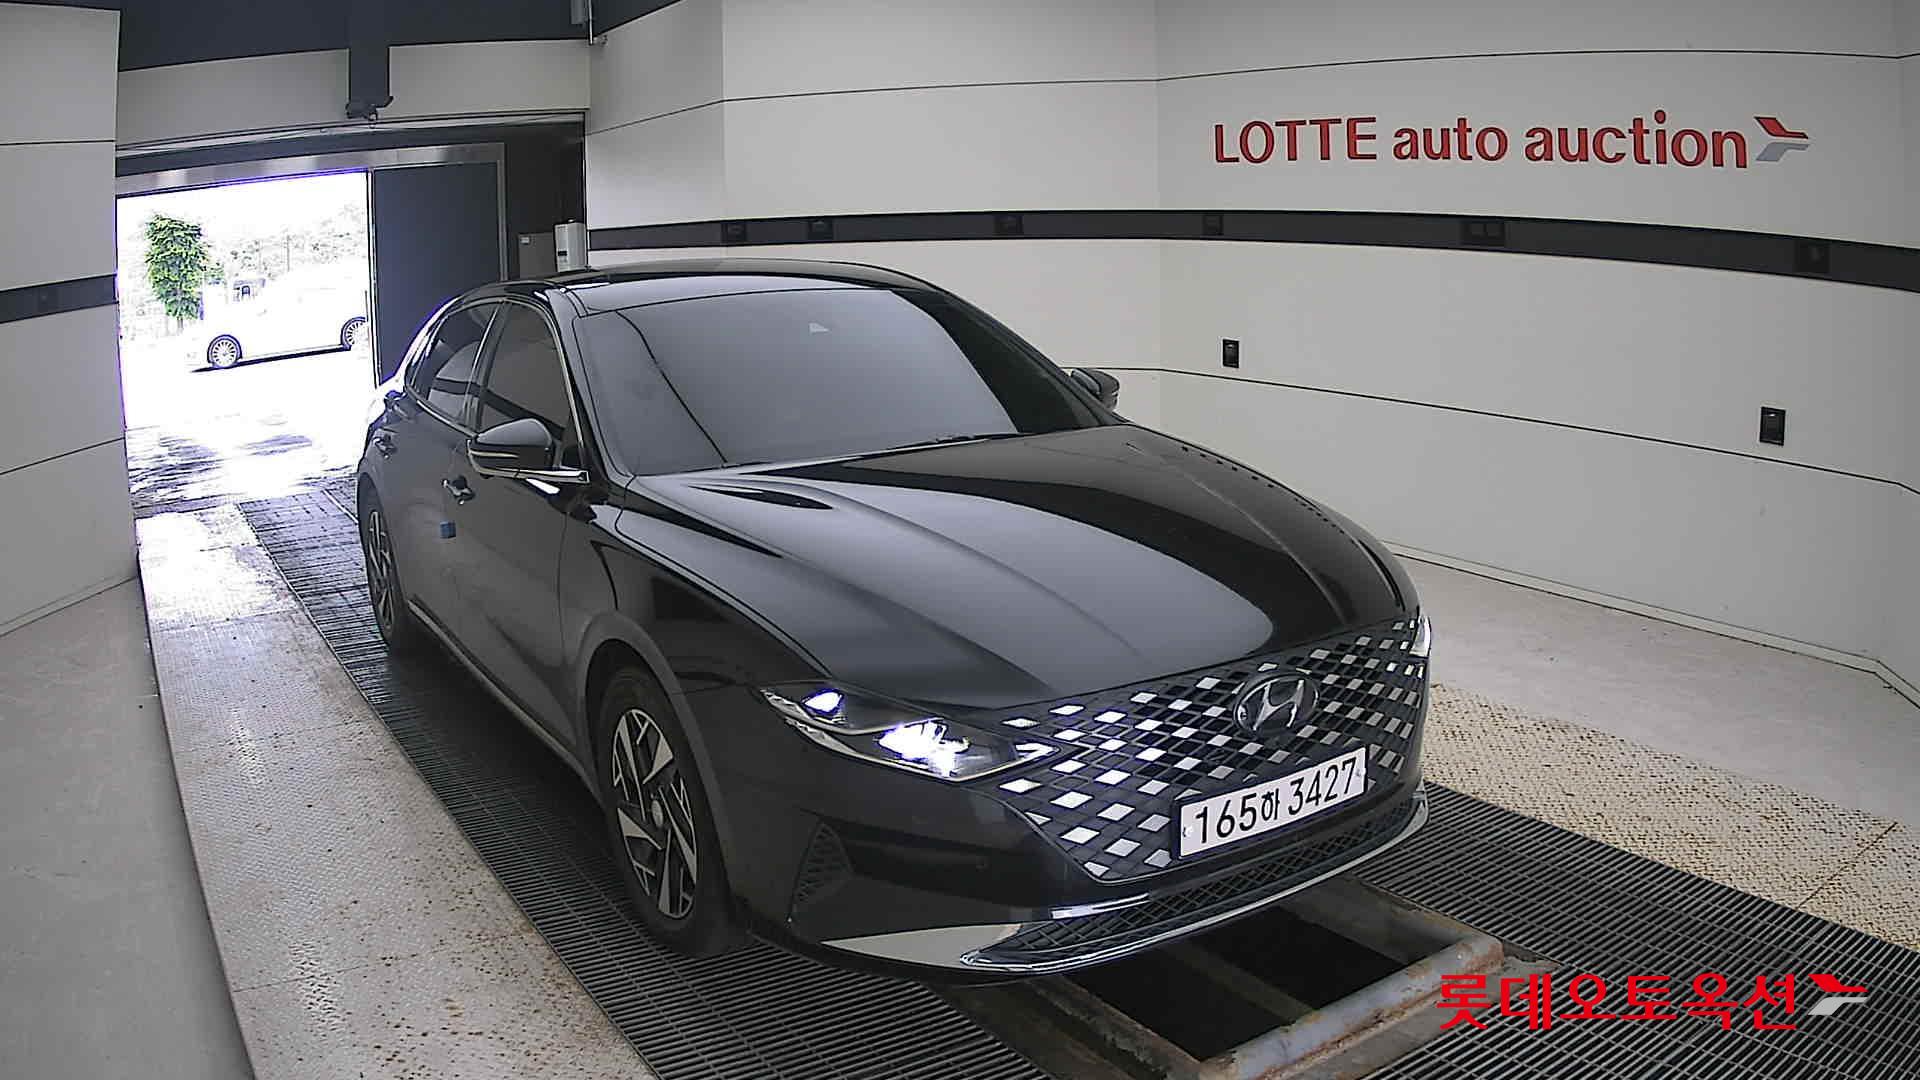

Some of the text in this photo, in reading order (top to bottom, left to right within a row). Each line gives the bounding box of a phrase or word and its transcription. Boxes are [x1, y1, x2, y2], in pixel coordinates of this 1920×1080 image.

[1214, 109, 1748, 169] LOTTE auto auction
[1195, 756, 1357, 844] 165하 3427
